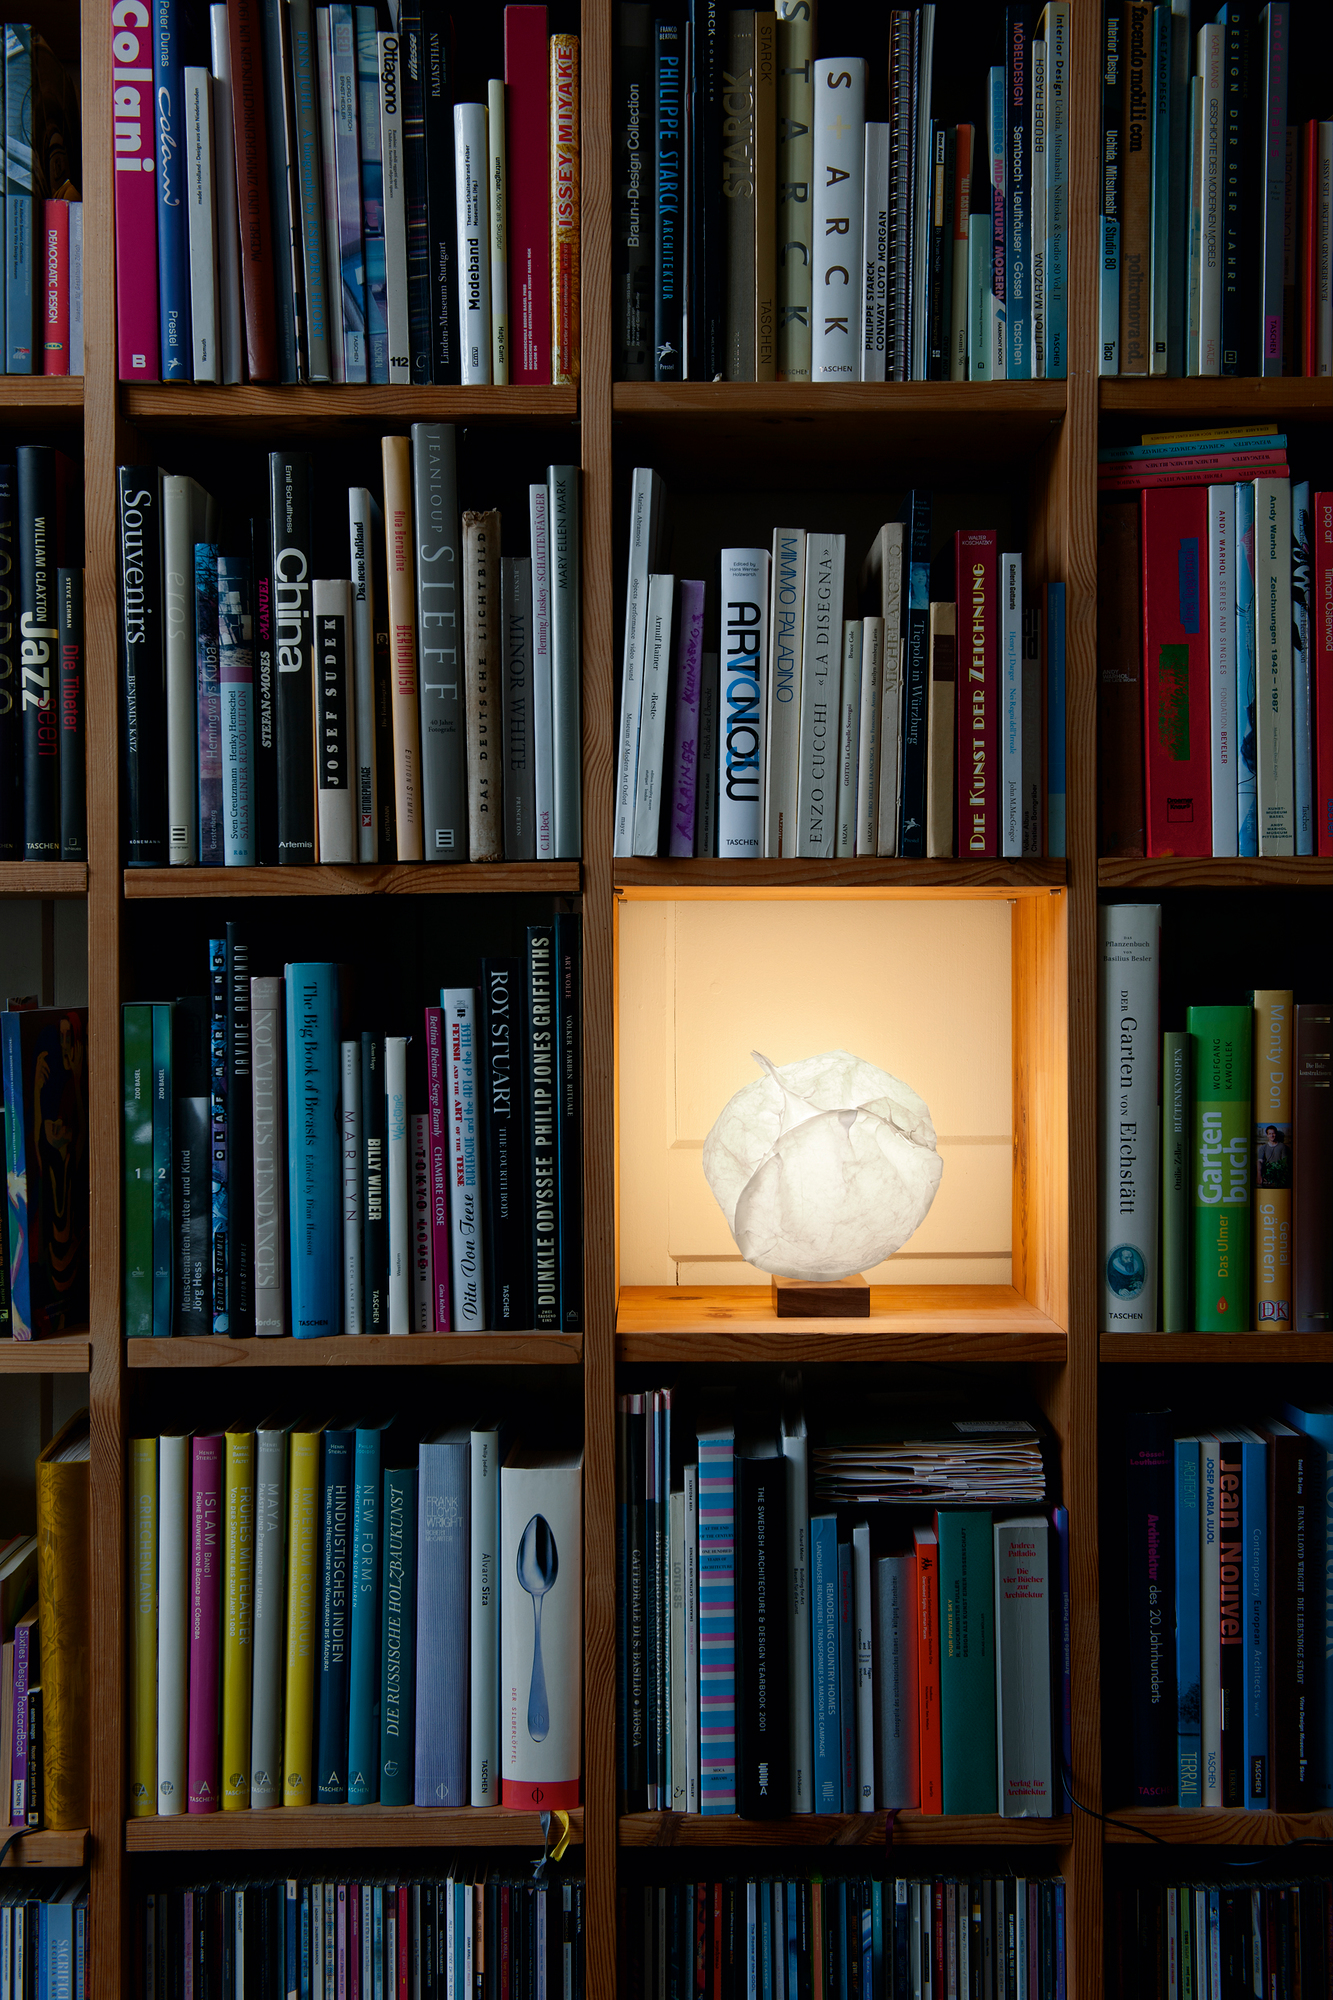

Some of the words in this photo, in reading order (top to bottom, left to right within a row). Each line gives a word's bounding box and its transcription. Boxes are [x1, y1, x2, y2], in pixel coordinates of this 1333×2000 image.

[159, 1, 170, 31] Peter
[1129, 6, 1147, 67] facendo
[160, 33, 171, 66] Dunas
[297, 31, 310, 68] FINN
[381, 38, 398, 114] Ottagono
[429, 33, 441, 97] RAJASTHAN
[1013, 22, 1025, 106] MÖBELDESIGN
[112, 0, 155, 172] Colani
[297, 73, 312, 114] JUHL
[558, 48, 573, 143] MIYAKE
[659, 56, 679, 139] PHILIPPE
[1131, 70, 1146, 121] mobili
[303, 129, 314, 138] A
[628, 84, 640, 150] Collection
[1129, 124, 1142, 152] con
[302, 143, 316, 198] biography
[494, 157, 503, 191] untragbar.
[780, 1, 811, 328] STARCK
[1014, 126, 1024, 181] Sembach
[305, 203, 317, 216] by
[558, 154, 574, 228] ISSEY
[627, 153, 640, 247] Braun+Design
[659, 151, 679, 214] STARCK
[495, 224, 503, 249] Skulptur
[877, 211, 886, 261] MORGAN
[1013, 191, 1024, 252] Leuthäuser
[48, 230, 58, 287] DEMOCRATIC
[306, 221, 321, 286] ESBJØRN
[437, 242, 448, 282] Stuttgart
[468, 239, 481, 310] Modeband
[662, 220, 674, 299] ARCHITEKTUR
[877, 262, 885, 299] LLOYD
[1013, 262, 1024, 299] Gössel
[48, 291, 58, 323] DESIGN
[168, 311, 178, 346] Prestel
[312, 292, 323, 340] HIORT
[440, 285, 450, 364] Linden-Museum
[761, 299, 772, 364] TASCHEN
[866, 306, 874, 350] PHILIPPE
[876, 304, 884, 351] CONWAY
[390, 356, 408, 367] 112
[1013, 320, 1024, 365] Taschen
[426, 434, 442, 533] JEANLOUP
[557, 480, 567, 512] MARK
[1269, 496, 1278, 519] Andy
[33, 517, 48, 567] WILLIAM
[557, 518, 568, 552] ELLEN
[635, 515, 644, 547] Abramović
[1270, 522, 1278, 559] Warhol
[124, 490, 152, 643] Souvenirs
[477, 533, 487, 639] LICHTBILD
[558, 556, 568, 589] MARY
[779, 538, 798, 604] MIMMO
[35, 571, 48, 622] CLAXTON
[258, 578, 269, 639] MANUEL
[276, 547, 309, 673] China
[421, 544, 458, 700] SIEFF
[1269, 576, 1279, 644] Zeichnungen
[510, 614, 525, 691] MINOR
[654, 615, 663, 641] Arnulf
[912, 621, 924, 666] Tiepolo
[62, 645, 78, 670] Die
[260, 651, 271, 698] MOSES
[324, 619, 337, 697] SUDEK
[653, 643, 662, 670] Rainer
[777, 611, 795, 702] PALADINO
[913, 670, 922, 681] in
[37, 697, 58, 755] seen
[63, 677, 79, 732] Tibeter
[128, 676, 136, 725] BENJAMIN
[261, 699, 272, 748] STEFAN
[479, 658, 487, 760] DEUTSCHE
[907, 685, 922, 745] Würzburg
[1271, 687, 1279, 712] 1987
[129, 728, 137, 752] KATZ
[326, 711, 340, 785] JOSEF
[510, 698, 526, 770] WHITE
[813, 703, 826, 780] CUCCHI
[480, 779, 489, 812] DAS
[809, 788, 824, 843] ENZO
[541, 811, 550, 851] C.H.Beck
[303, 982, 318, 1009] The
[491, 970, 510, 1017] ROY
[531, 938, 550, 1025] GRIFFITHS
[299, 1014, 316, 1037] Big
[1120, 1017, 1137, 1088] Garten
[1267, 1004, 1285, 1062] Monty
[254, 1011, 274, 1143] NOUVELLES
[304, 1042, 318, 1075] Book
[492, 1024, 511, 1118] STUART
[533, 1033, 551, 1085] JONES
[304, 1080, 319, 1092] of
[1269, 1072, 1284, 1109] Don
[305, 1096, 320, 1146] Breasts
[534, 1088, 553, 1146] PHILIP
[344, 1111, 357, 1221] MARILYN
[368, 1139, 381, 1170] BILLY
[1120, 1122, 1137, 1214] Eichstätt
[1198, 1112, 1223, 1203] Garten
[1223, 1136, 1248, 1203] buch
[256, 1151, 276, 1286] TENDANCES
[368, 1173, 382, 1220] WILDER
[536, 1156, 553, 1230] ODYSSEE
[1260, 1204, 1278, 1284] gärtnern
[537, 1239, 555, 1305] DUNKLE
[1205, 1458, 1214, 1484] JOSEP
[1219, 1459, 1241, 1527] Jean
[204, 1491, 217, 1545] ISLAM
[363, 1485, 375, 1527] NEW
[1206, 1486, 1214, 1515] MARIA
[333, 1485, 346, 1607] HINDUISTISCHES
[388, 1485, 404, 1613] HOLZBAUKUNST
[1147, 1514, 1159, 1580] Architektur
[1206, 1518, 1214, 1544] JUJOL
[361, 1533, 373, 1592] FORMS
[480, 1552, 491, 1583] Álvaro
[481, 1586, 490, 1606] Siza
[1149, 1585, 1160, 1605] des
[1149, 1609, 1161, 1626] 20.
[1221, 1542, 1242, 1644] Nouvel
[17, 1630, 28, 1659] Sixties
[332, 1612, 344, 1663] INDIEN
[387, 1618, 402, 1706] RUSSISCHE
[15, 1662, 27, 1693] Design
[1148, 1630, 1162, 1703] Jahrhunderts
[16, 1696, 26, 1757] PostcardBook
[387, 1708, 400, 1737] DIE
[1180, 1752, 1197, 1796] TERRAIL
[57, 1939, 68, 2000] SACRIFICI
